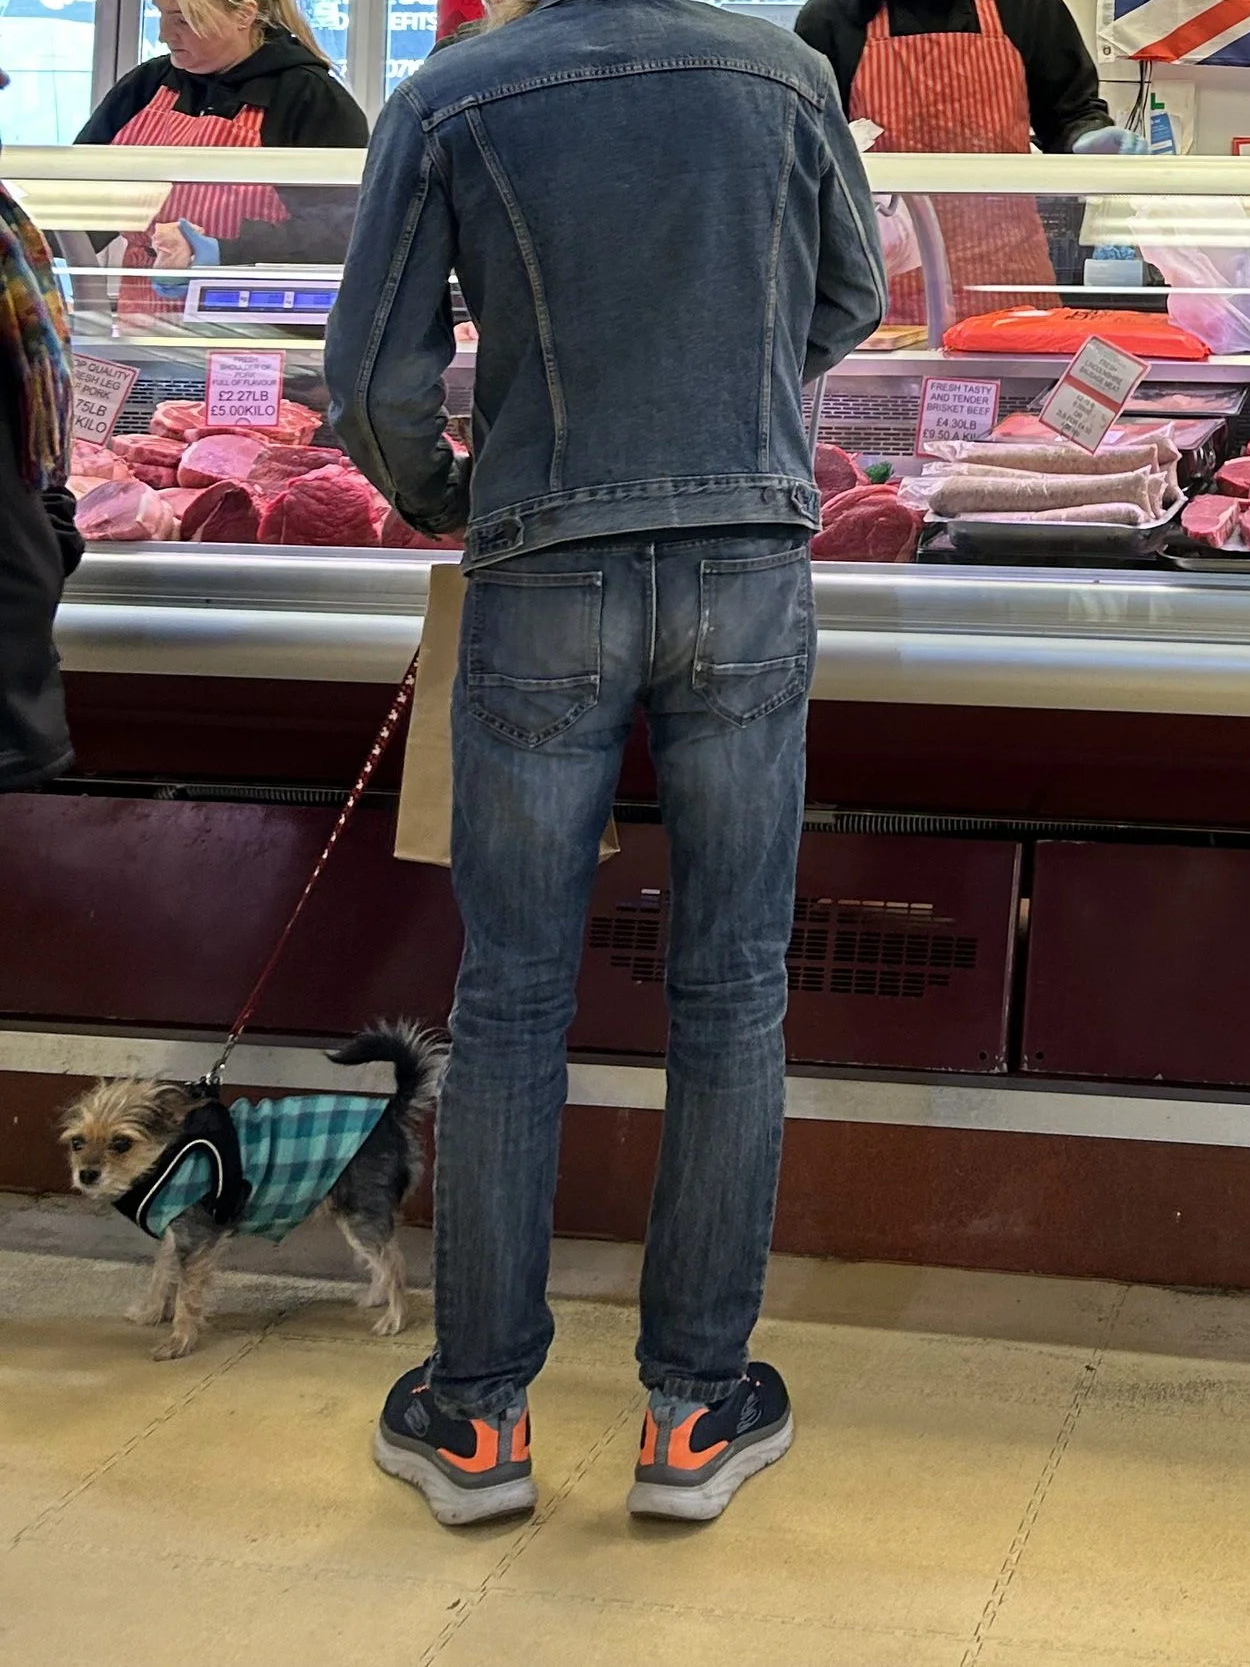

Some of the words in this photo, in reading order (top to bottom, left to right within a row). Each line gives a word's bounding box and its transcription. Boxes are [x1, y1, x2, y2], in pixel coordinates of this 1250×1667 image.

[88, 363, 130, 381] QUALITY
[99, 377, 121, 391] LEG
[931, 382, 961, 393] FRESH
[964, 384, 992, 395] TASTY
[83, 385, 111, 400] PORK
[218, 390, 269, 403] £2.27LB
[930, 393, 950, 402] AND
[952, 394, 989, 405] TENDER
[210, 405, 276, 417] £5.00KILO
[926, 403, 965, 413] BRISKET
[966, 406, 991, 415] BEEF
[74, 416, 108, 434] KILO
[936, 418, 977, 430] £4.30LB
[952, 431, 960, 440] A
